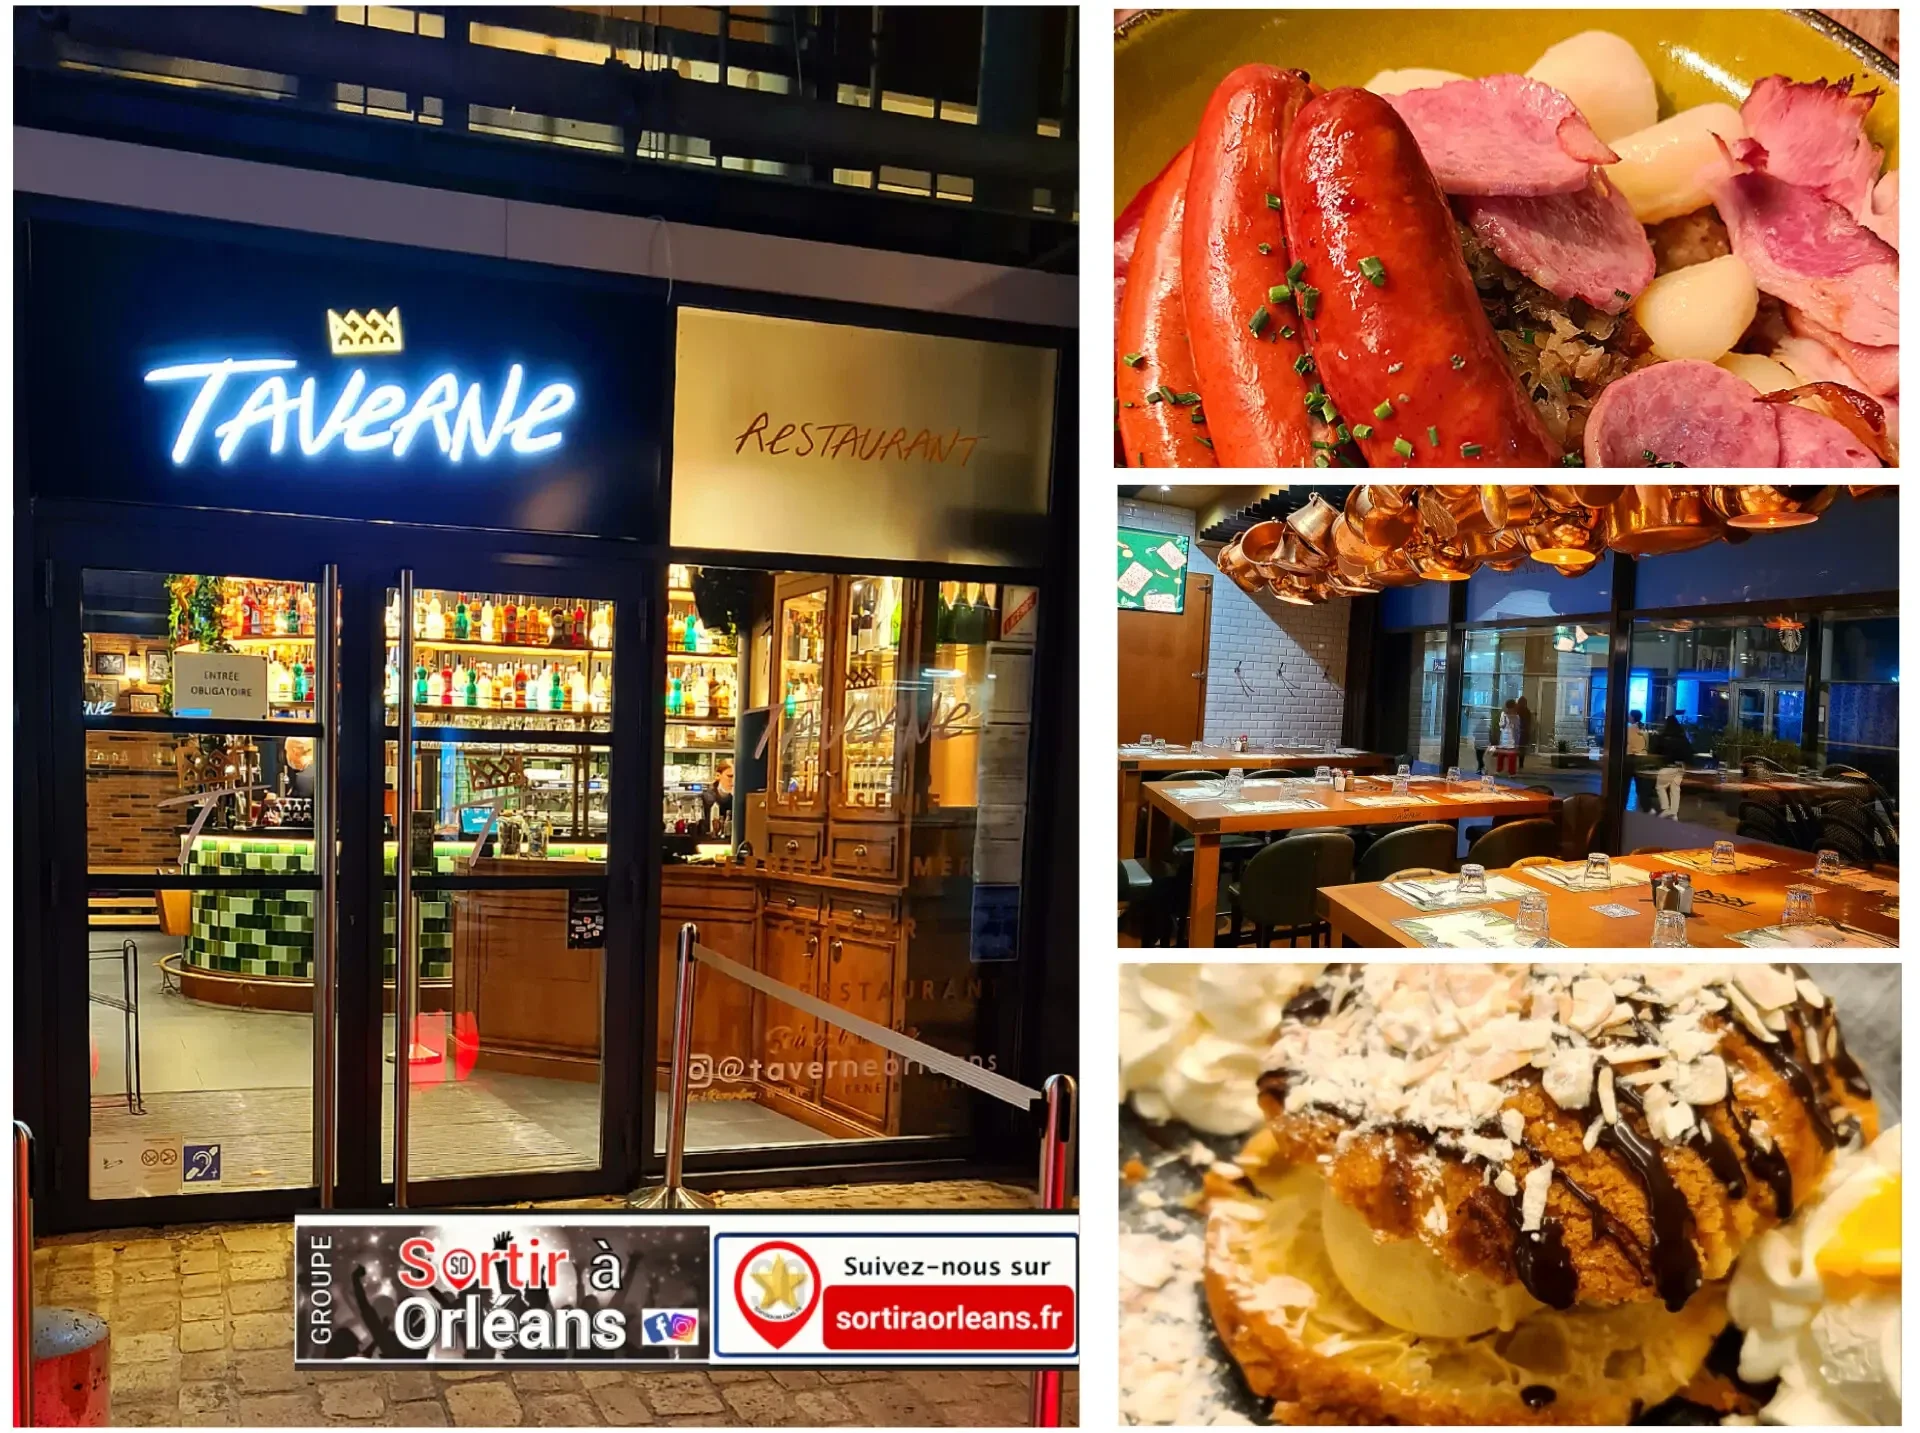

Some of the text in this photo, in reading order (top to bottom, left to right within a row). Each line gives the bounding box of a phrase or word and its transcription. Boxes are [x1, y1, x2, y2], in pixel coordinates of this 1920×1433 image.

[203, 670, 240, 682] ENTRÉE
[190, 685, 252, 698] OBLIGATOIRE
[718, 1053, 997, 1083] @taverneorns
